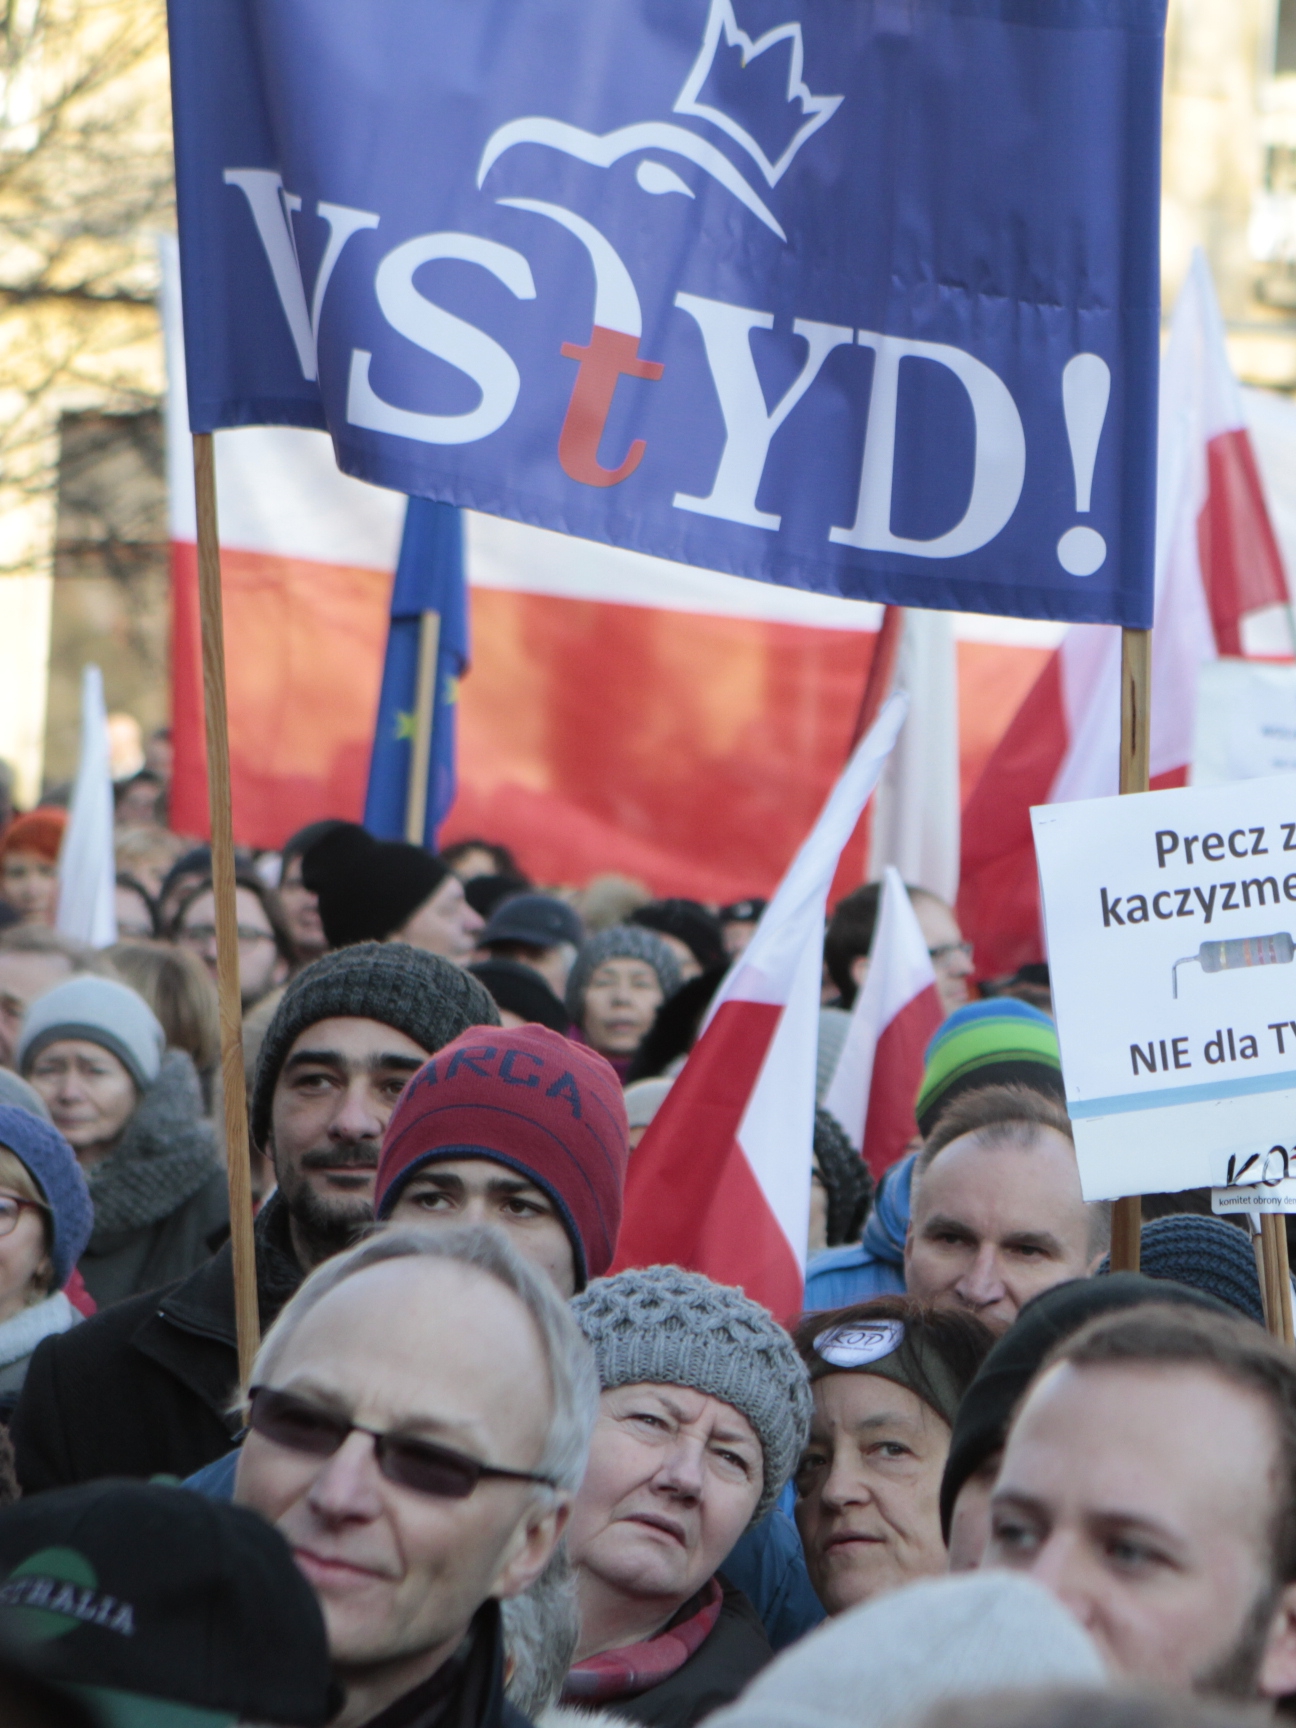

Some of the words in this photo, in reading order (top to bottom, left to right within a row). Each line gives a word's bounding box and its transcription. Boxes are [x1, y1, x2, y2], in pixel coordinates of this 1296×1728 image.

[1155, 827, 1269, 869] Precz
[1129, 1036, 1192, 1076] NIE
[1203, 1027, 1259, 1065] dla
[1219, 1196, 1251, 1206] komitet
[1253, 1195, 1282, 1206] obrony
